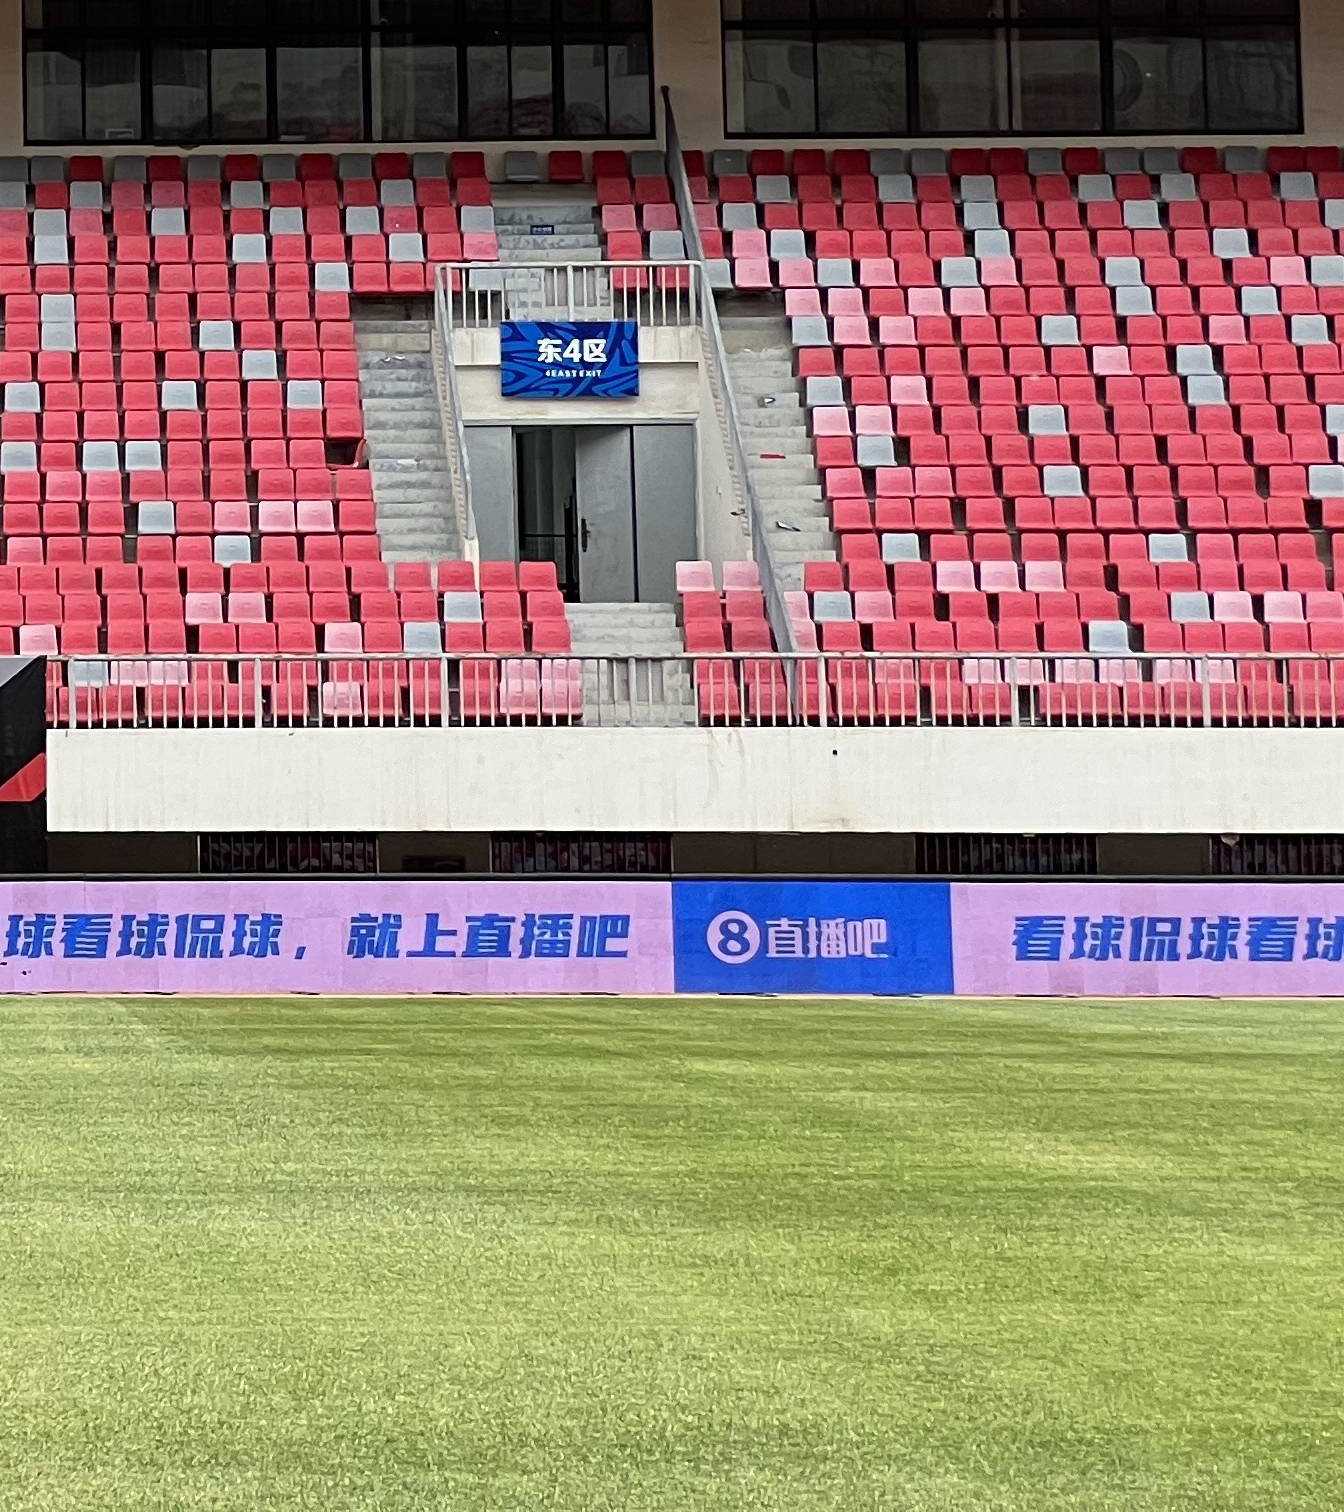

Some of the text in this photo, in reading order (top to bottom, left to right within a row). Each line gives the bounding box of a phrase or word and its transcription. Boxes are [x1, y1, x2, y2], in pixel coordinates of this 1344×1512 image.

[537, 338, 608, 363] 东4区
[765, 917, 889, 958] 直播吧
